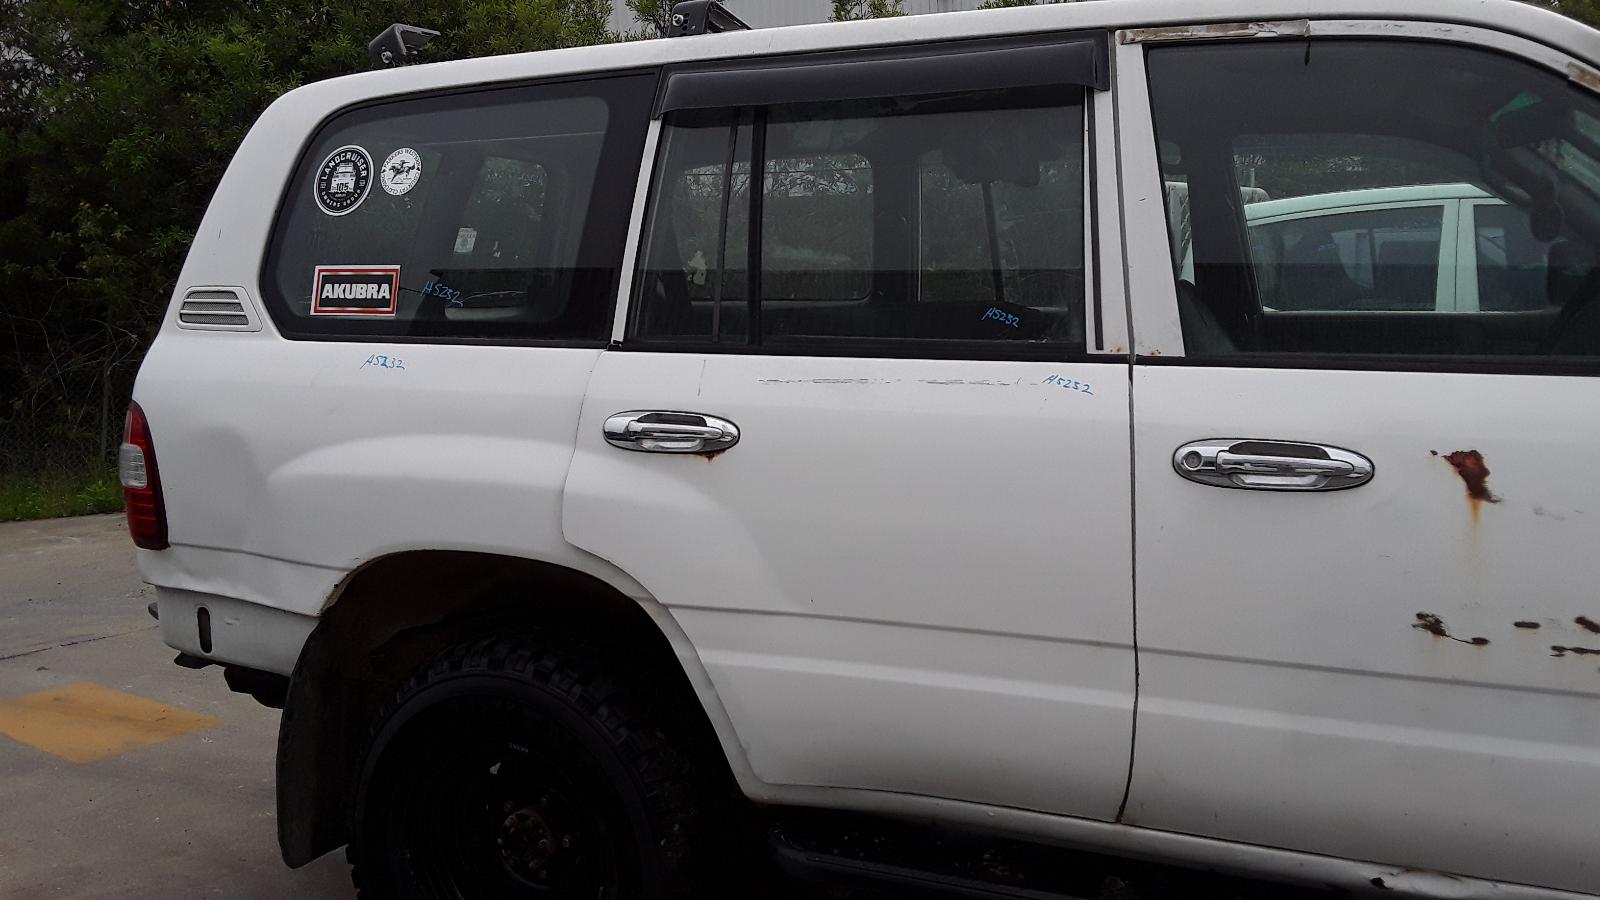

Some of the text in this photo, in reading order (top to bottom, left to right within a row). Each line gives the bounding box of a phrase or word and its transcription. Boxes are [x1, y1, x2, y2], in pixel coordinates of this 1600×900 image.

[321, 152, 368, 180] LANDCRUISER
[335, 182, 350, 192] 105
[321, 283, 391, 299] AKUBRA
